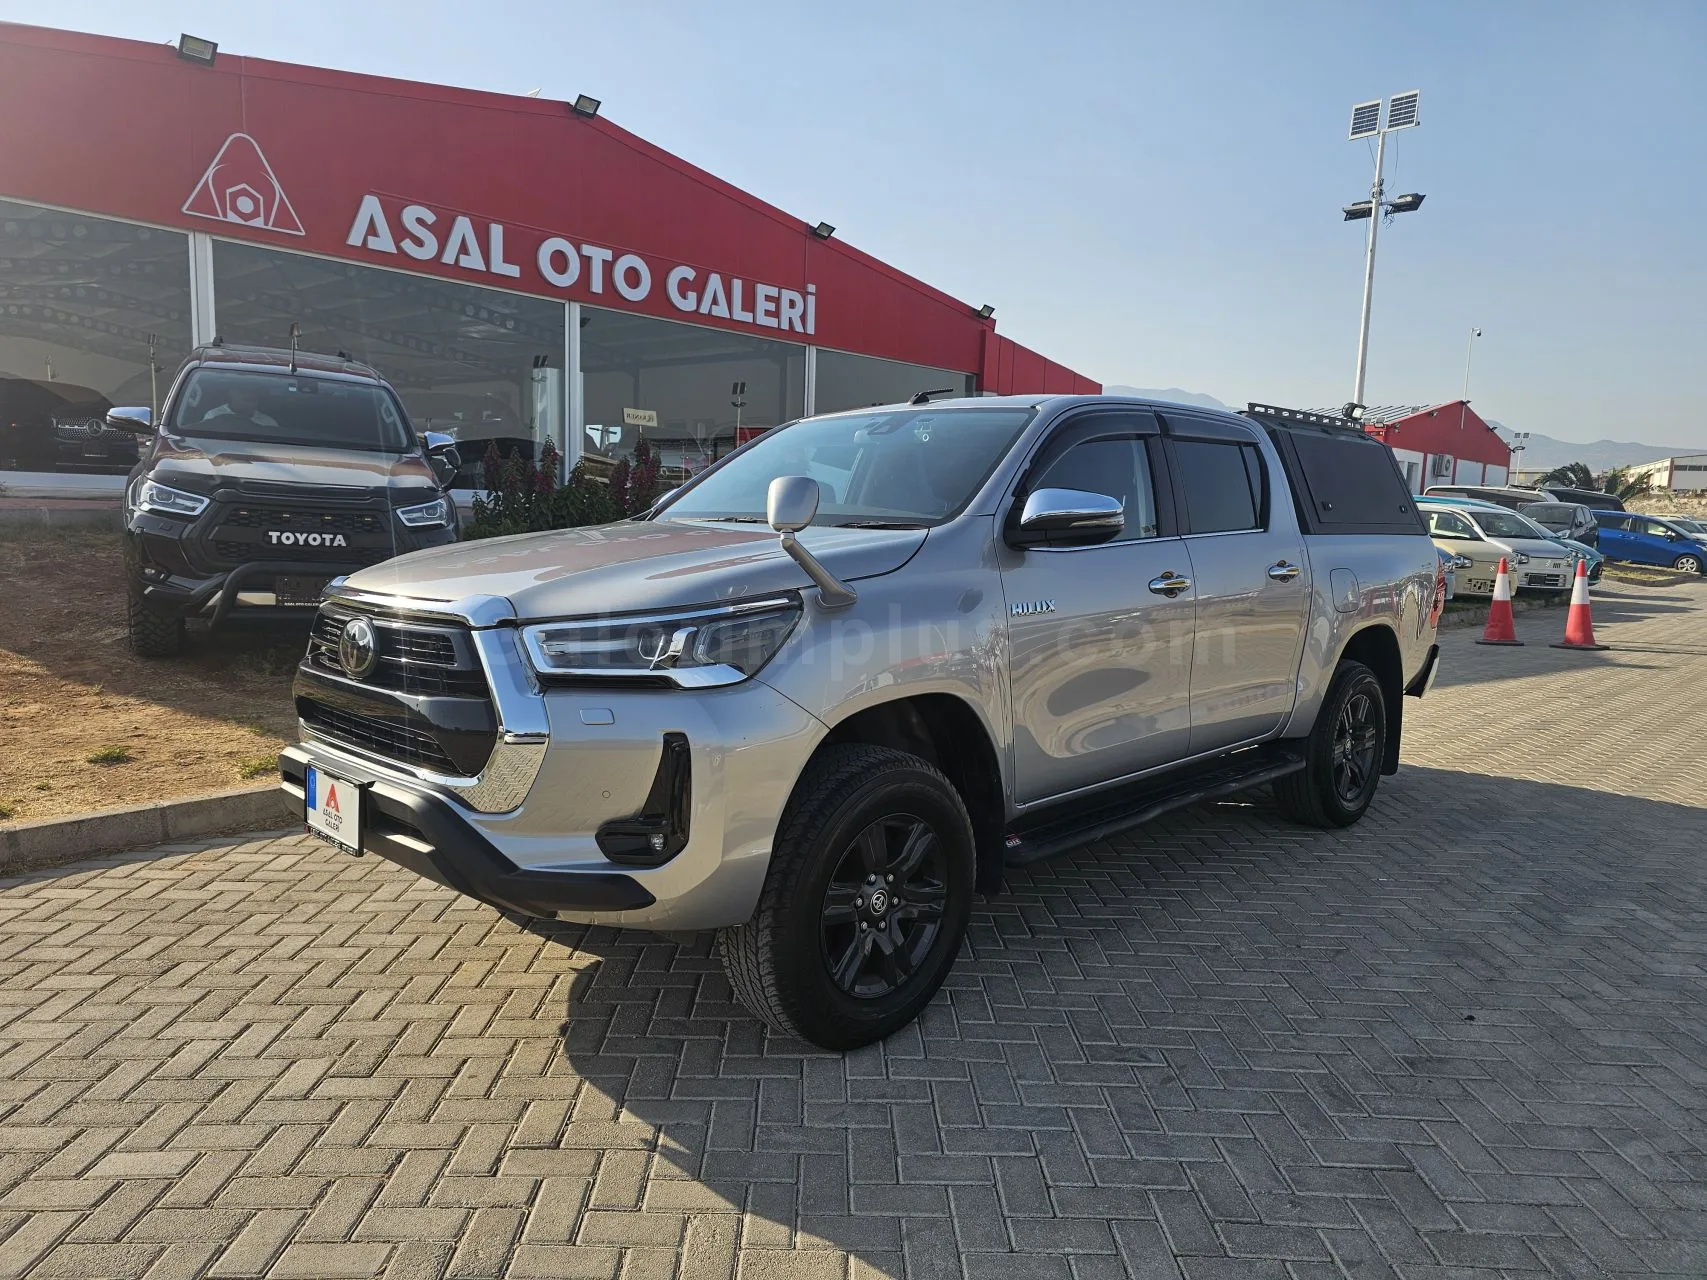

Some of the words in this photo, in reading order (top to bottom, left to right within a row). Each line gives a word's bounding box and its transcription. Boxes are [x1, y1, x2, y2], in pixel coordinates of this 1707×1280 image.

[345, 194, 521, 279] ASAL
[537, 237, 652, 303] OTO
[666, 265, 817, 335] GALERİ
[268, 531, 347, 547] TOYOTA
[1010, 599, 1056, 617] HILUX
